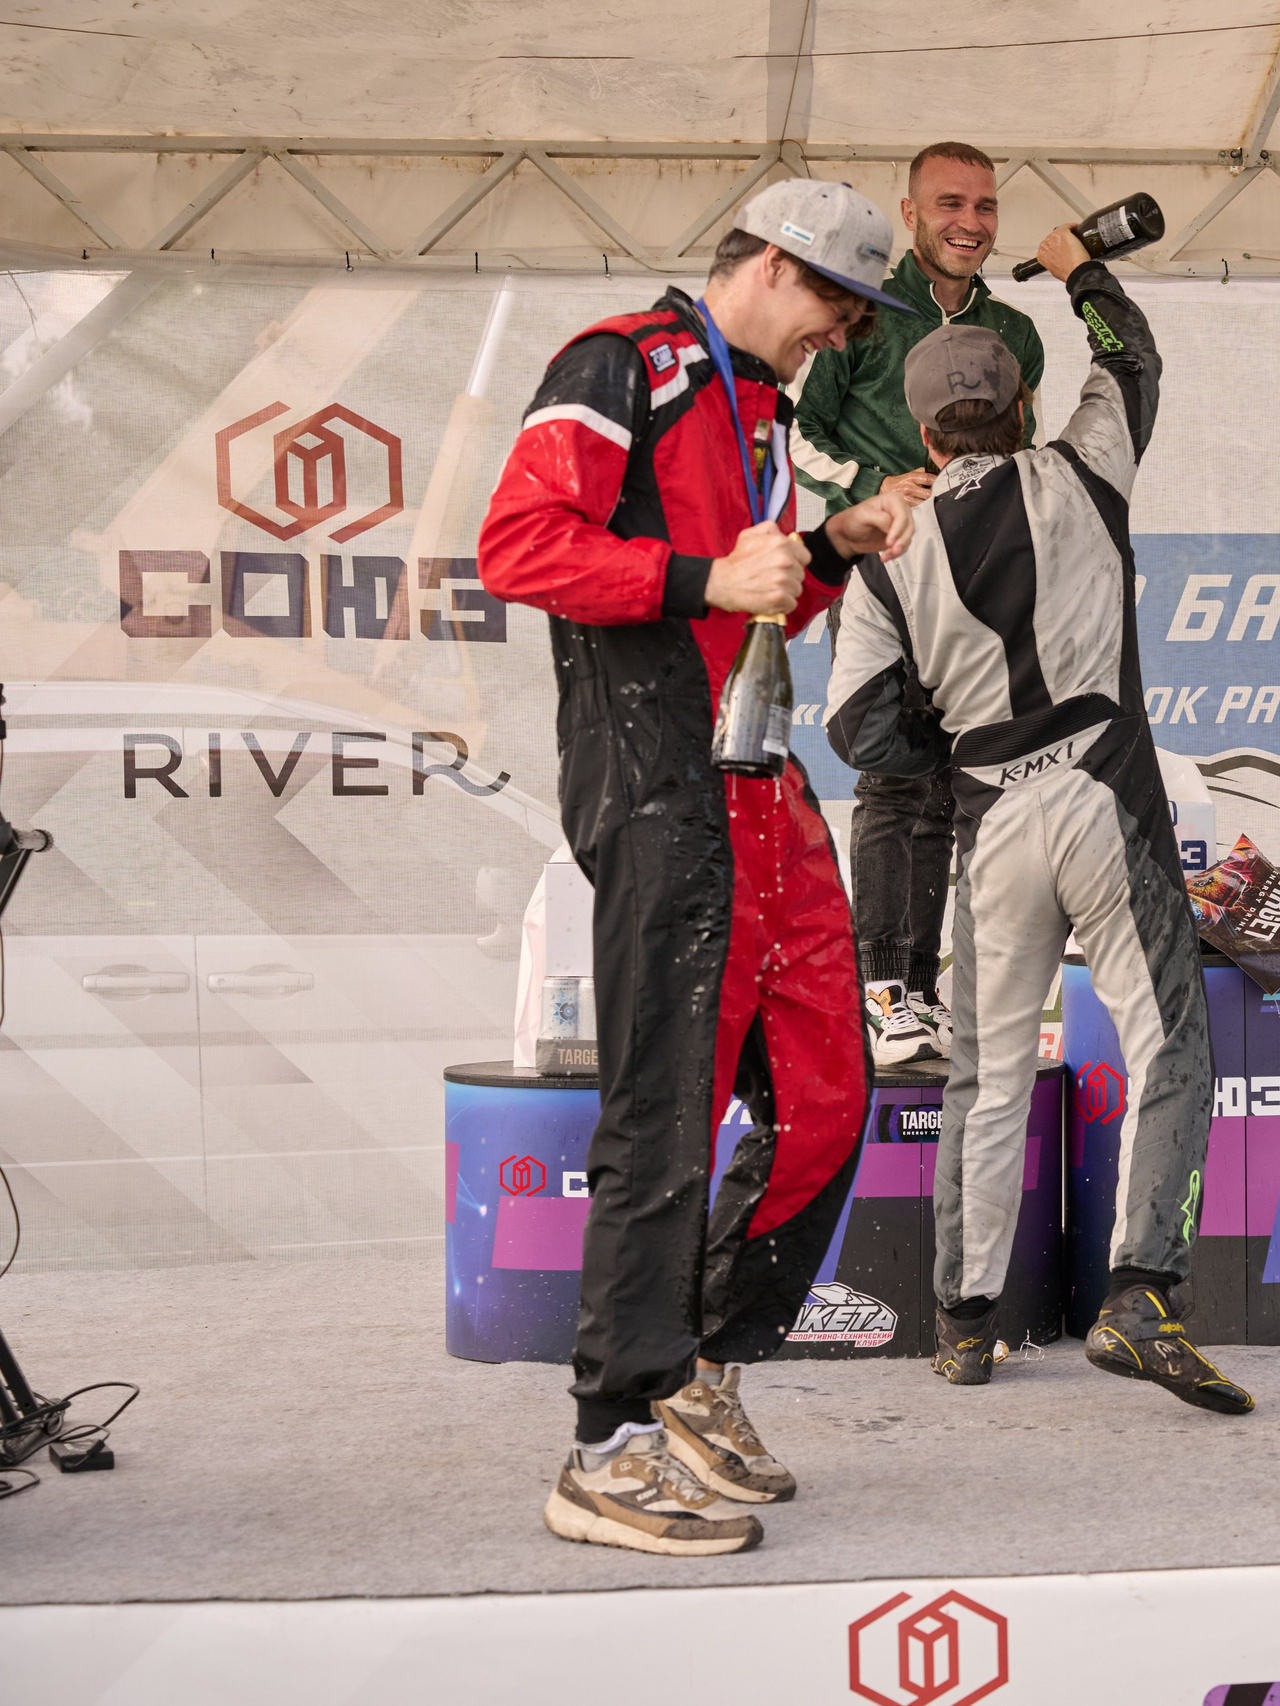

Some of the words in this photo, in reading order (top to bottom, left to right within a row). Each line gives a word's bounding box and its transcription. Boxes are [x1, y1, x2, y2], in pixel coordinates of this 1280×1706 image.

[123, 731, 511, 799] RIVER
[558, 1048, 599, 1065] TARGE
[900, 1111, 943, 1130] TARGE
[793, 1331, 893, 1341] СПОРТИВНО-ТЕХНИЧЕСКИЙ
